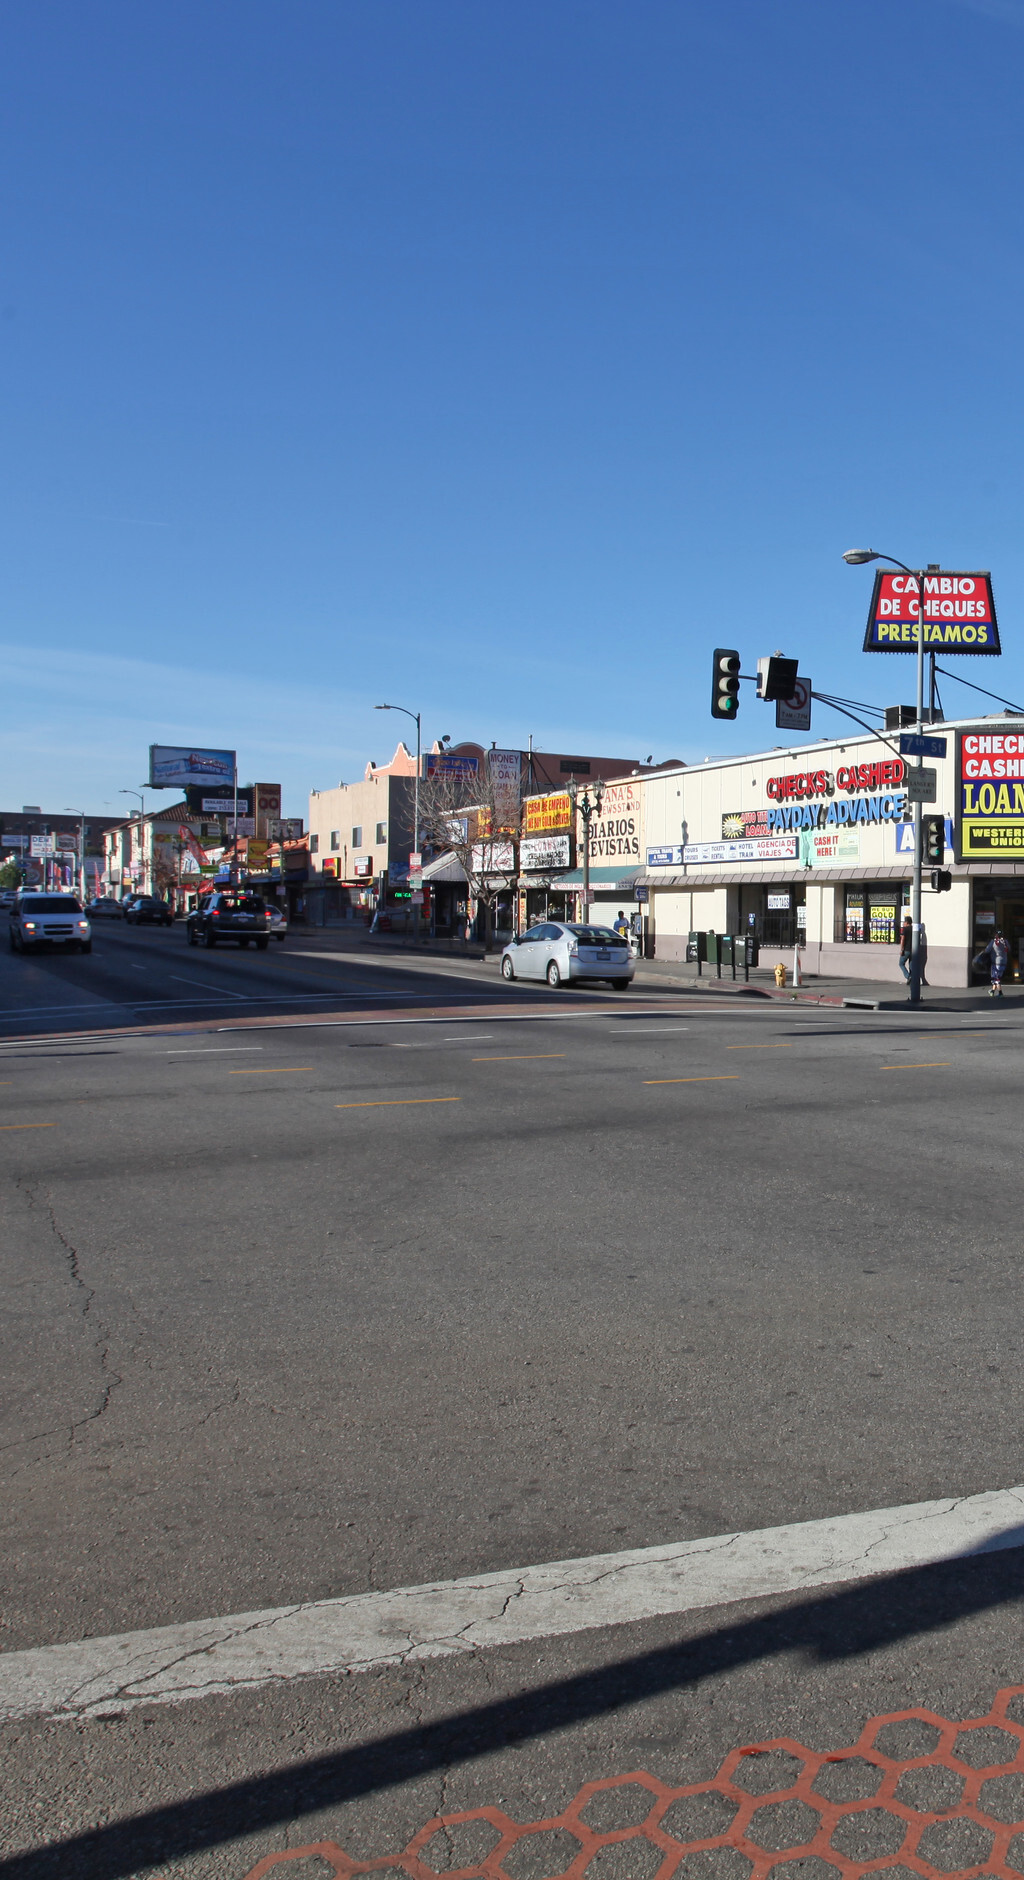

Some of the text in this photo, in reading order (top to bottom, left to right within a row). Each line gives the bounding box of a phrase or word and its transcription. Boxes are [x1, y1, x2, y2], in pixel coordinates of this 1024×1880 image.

[892, 576, 975, 594] CAMBIO
[881, 599, 985, 617] DE CHEQUES
[878, 623, 988, 643] PRESTAMOS
[904, 737, 943, 753] 7th St
[491, 754, 519, 764] MONEY
[767, 759, 904, 799] CHECKS CASHED
[741, 811, 757, 824] AUTO
[767, 793, 905, 830] PAYDAY ADVANCE
[589, 837, 639, 858] EVISTAS
[757, 839, 796, 849] AGENCIA DE
[814, 835, 839, 846] CASH IT
[758, 849, 782, 857] VIAJES
[816, 846, 832, 856] HERE
[768, 897, 790, 908] AUTO TAGS
